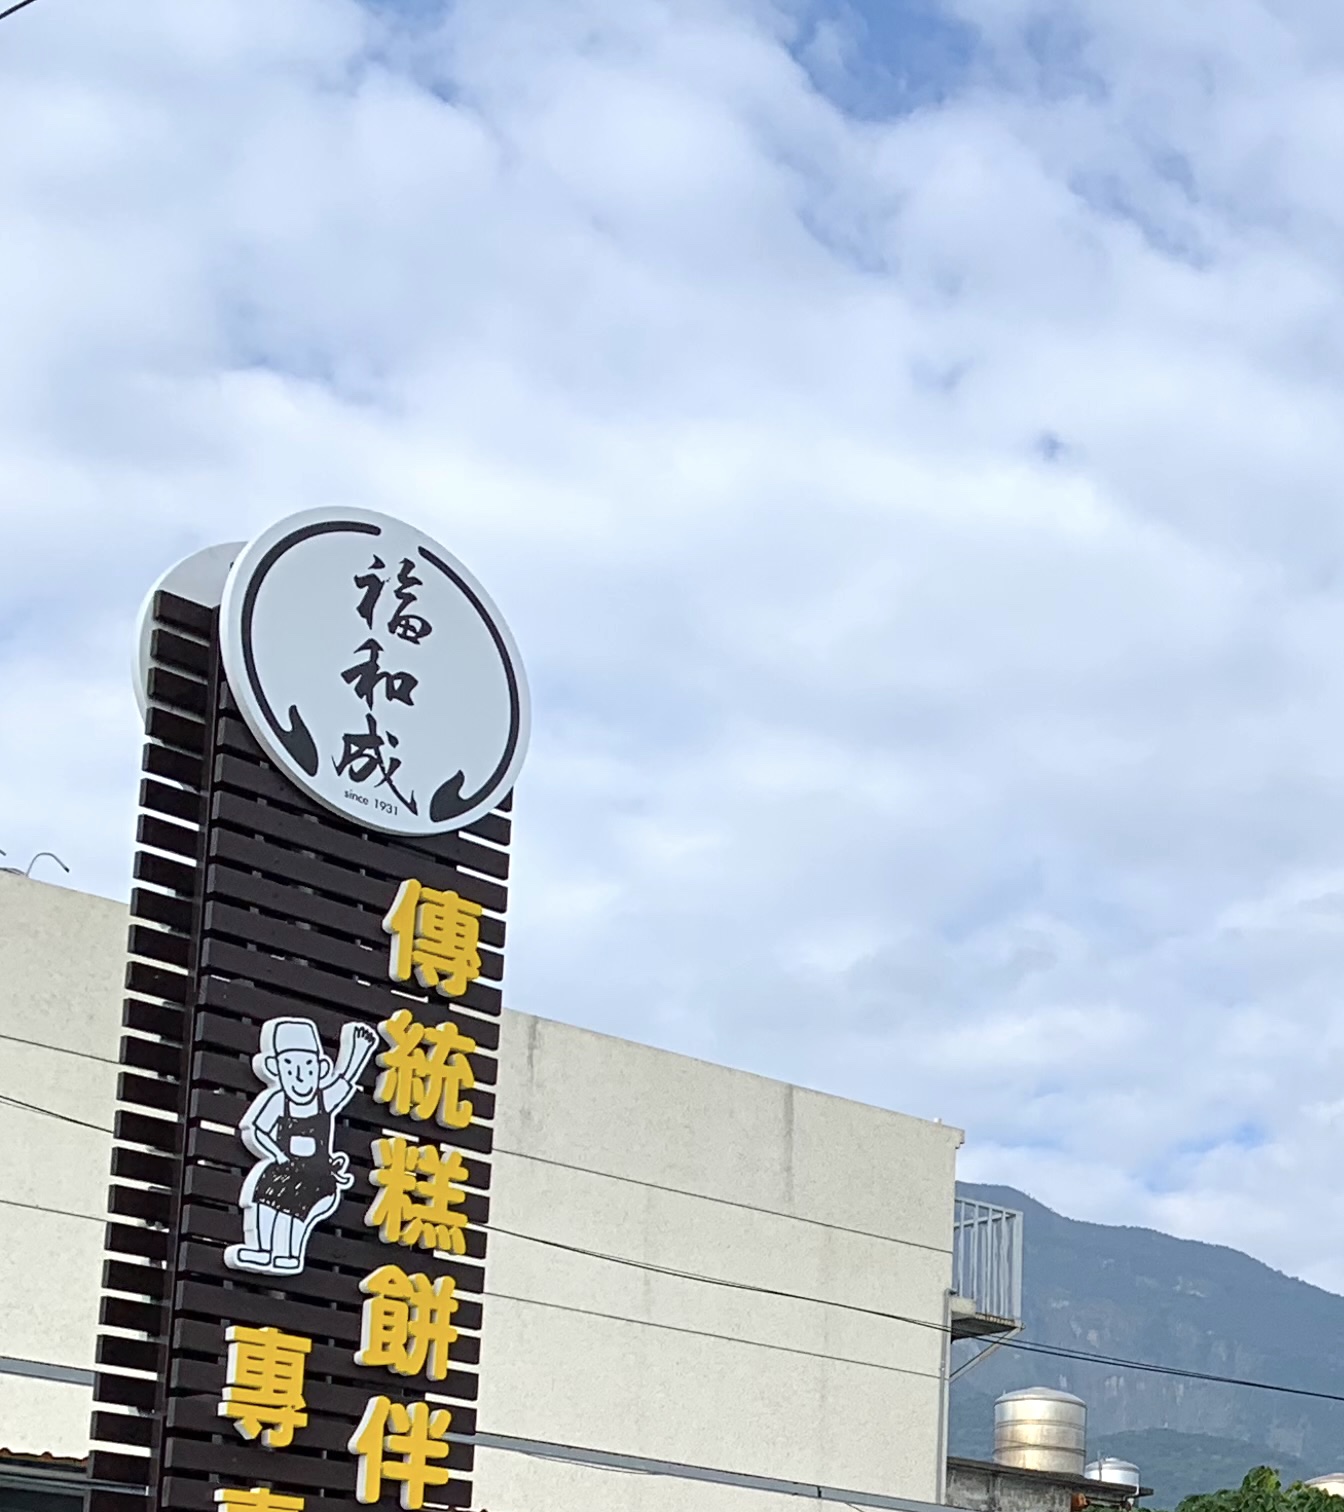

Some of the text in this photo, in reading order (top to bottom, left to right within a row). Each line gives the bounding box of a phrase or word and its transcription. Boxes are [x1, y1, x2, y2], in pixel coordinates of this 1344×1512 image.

[332, 554, 433, 816] 福和成
[344, 789, 398, 815] since 1931
